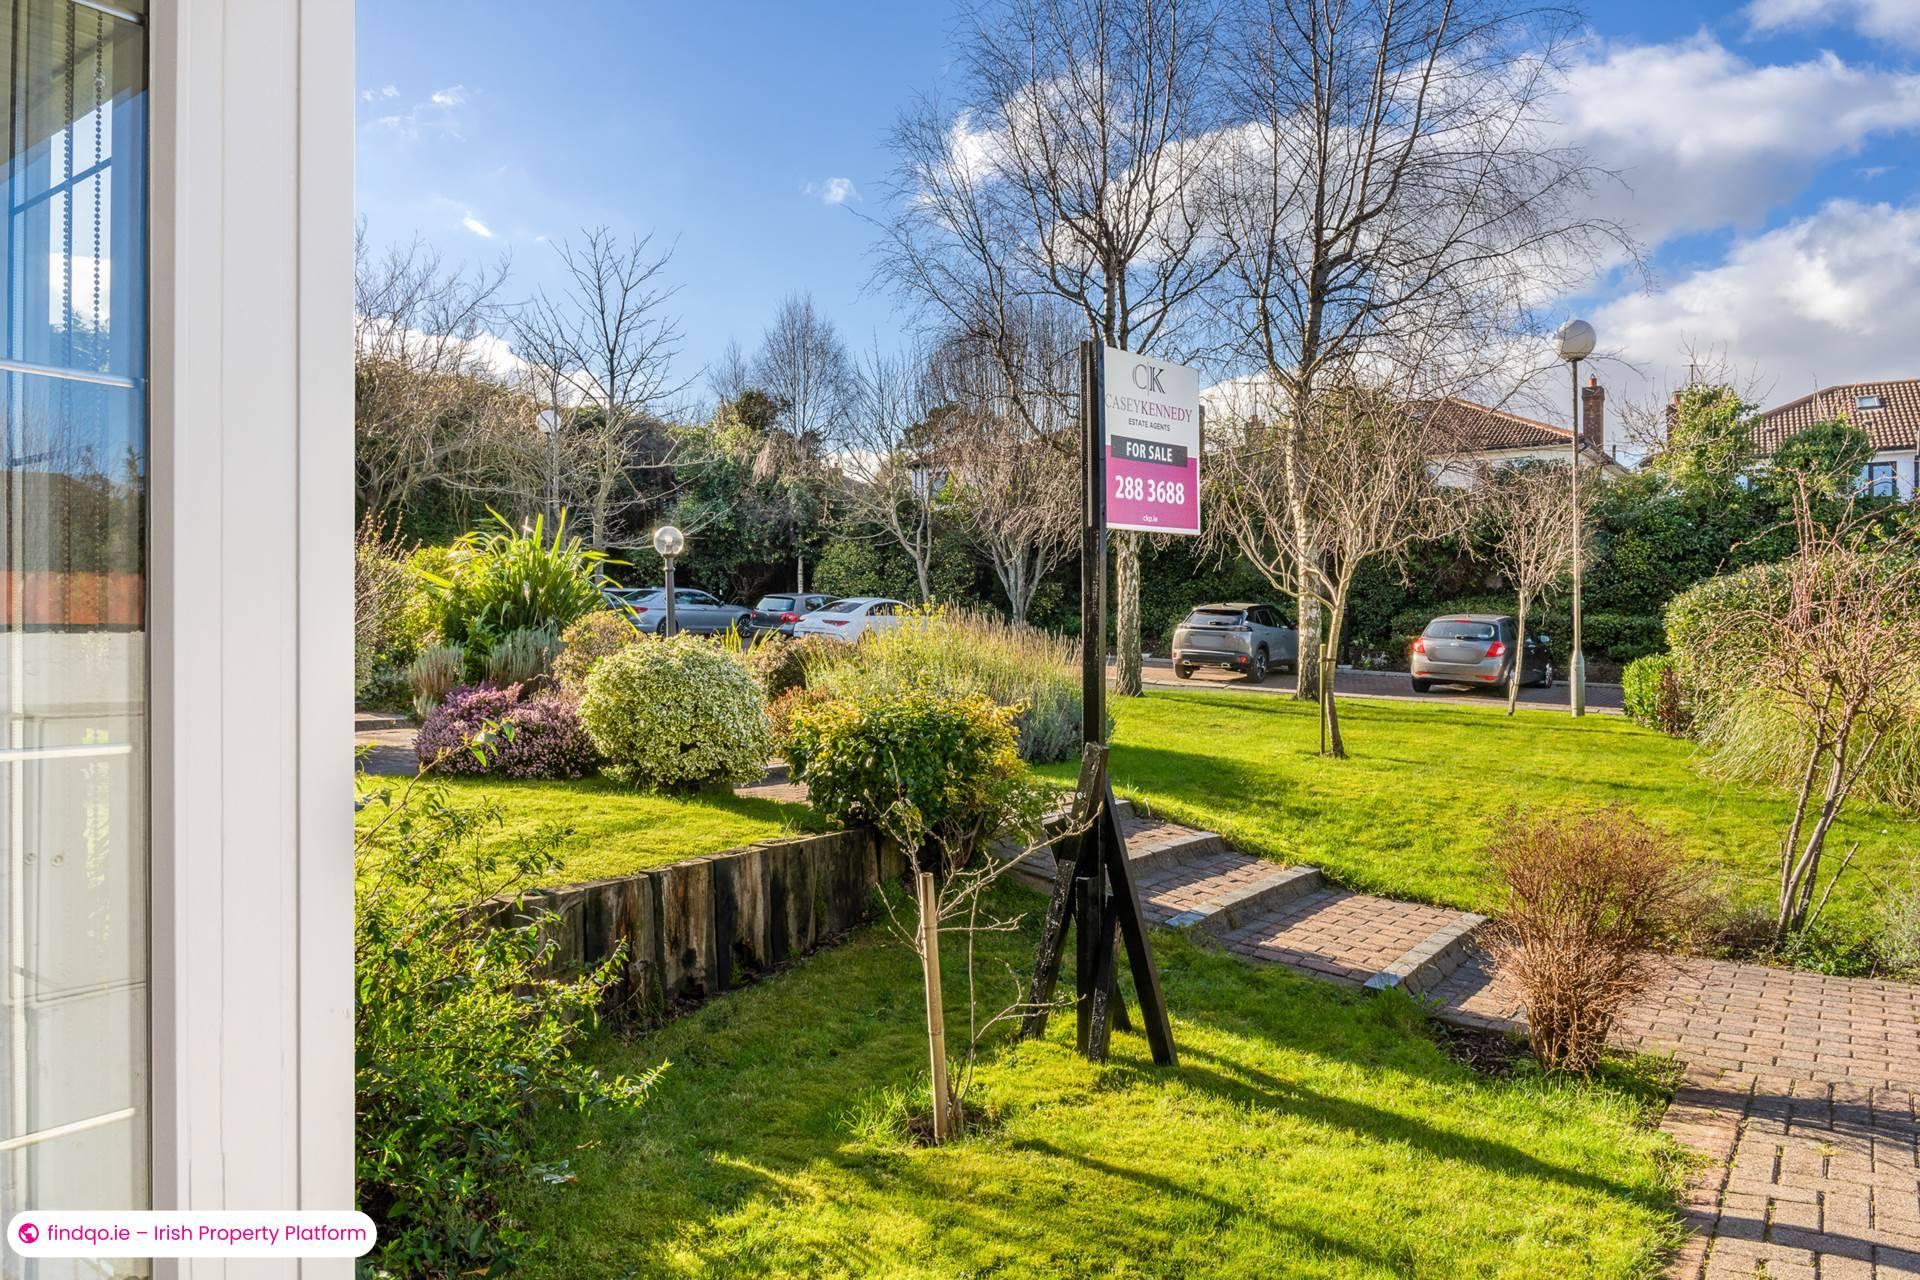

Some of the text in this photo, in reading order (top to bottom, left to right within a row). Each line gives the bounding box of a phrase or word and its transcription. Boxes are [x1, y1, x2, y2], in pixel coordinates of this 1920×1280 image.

[1128, 417, 1170, 431] ESTATE AGENTS
[1126, 441, 1173, 463] FOR SALE
[1115, 475, 1185, 505] 288 3688
